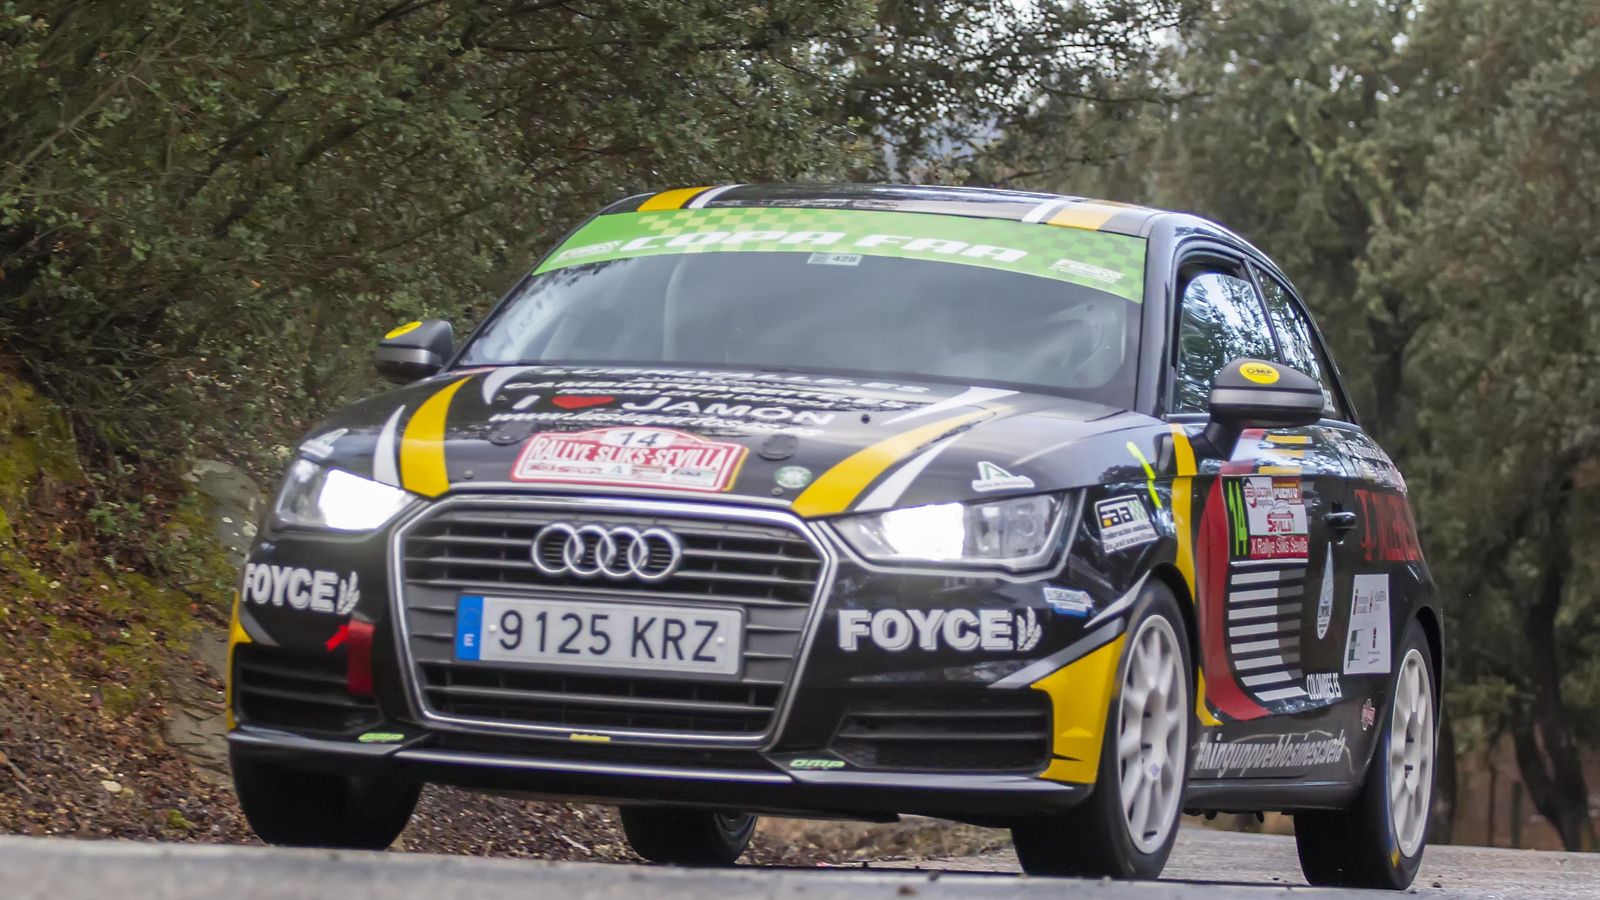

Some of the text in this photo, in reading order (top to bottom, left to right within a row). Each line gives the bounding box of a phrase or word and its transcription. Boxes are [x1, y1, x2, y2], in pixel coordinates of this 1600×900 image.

[619, 231, 1029, 263] COPA FAA
[512, 395, 541, 410] I
[529, 439, 598, 463] RALLYE
[621, 431, 662, 447] 14
[1226, 480, 1248, 556] 14
[241, 562, 339, 613] FOYCE
[463, 633, 474, 647] E
[499, 609, 720, 663] 9125 KRZ
[838, 608, 1014, 651] FOYCE
